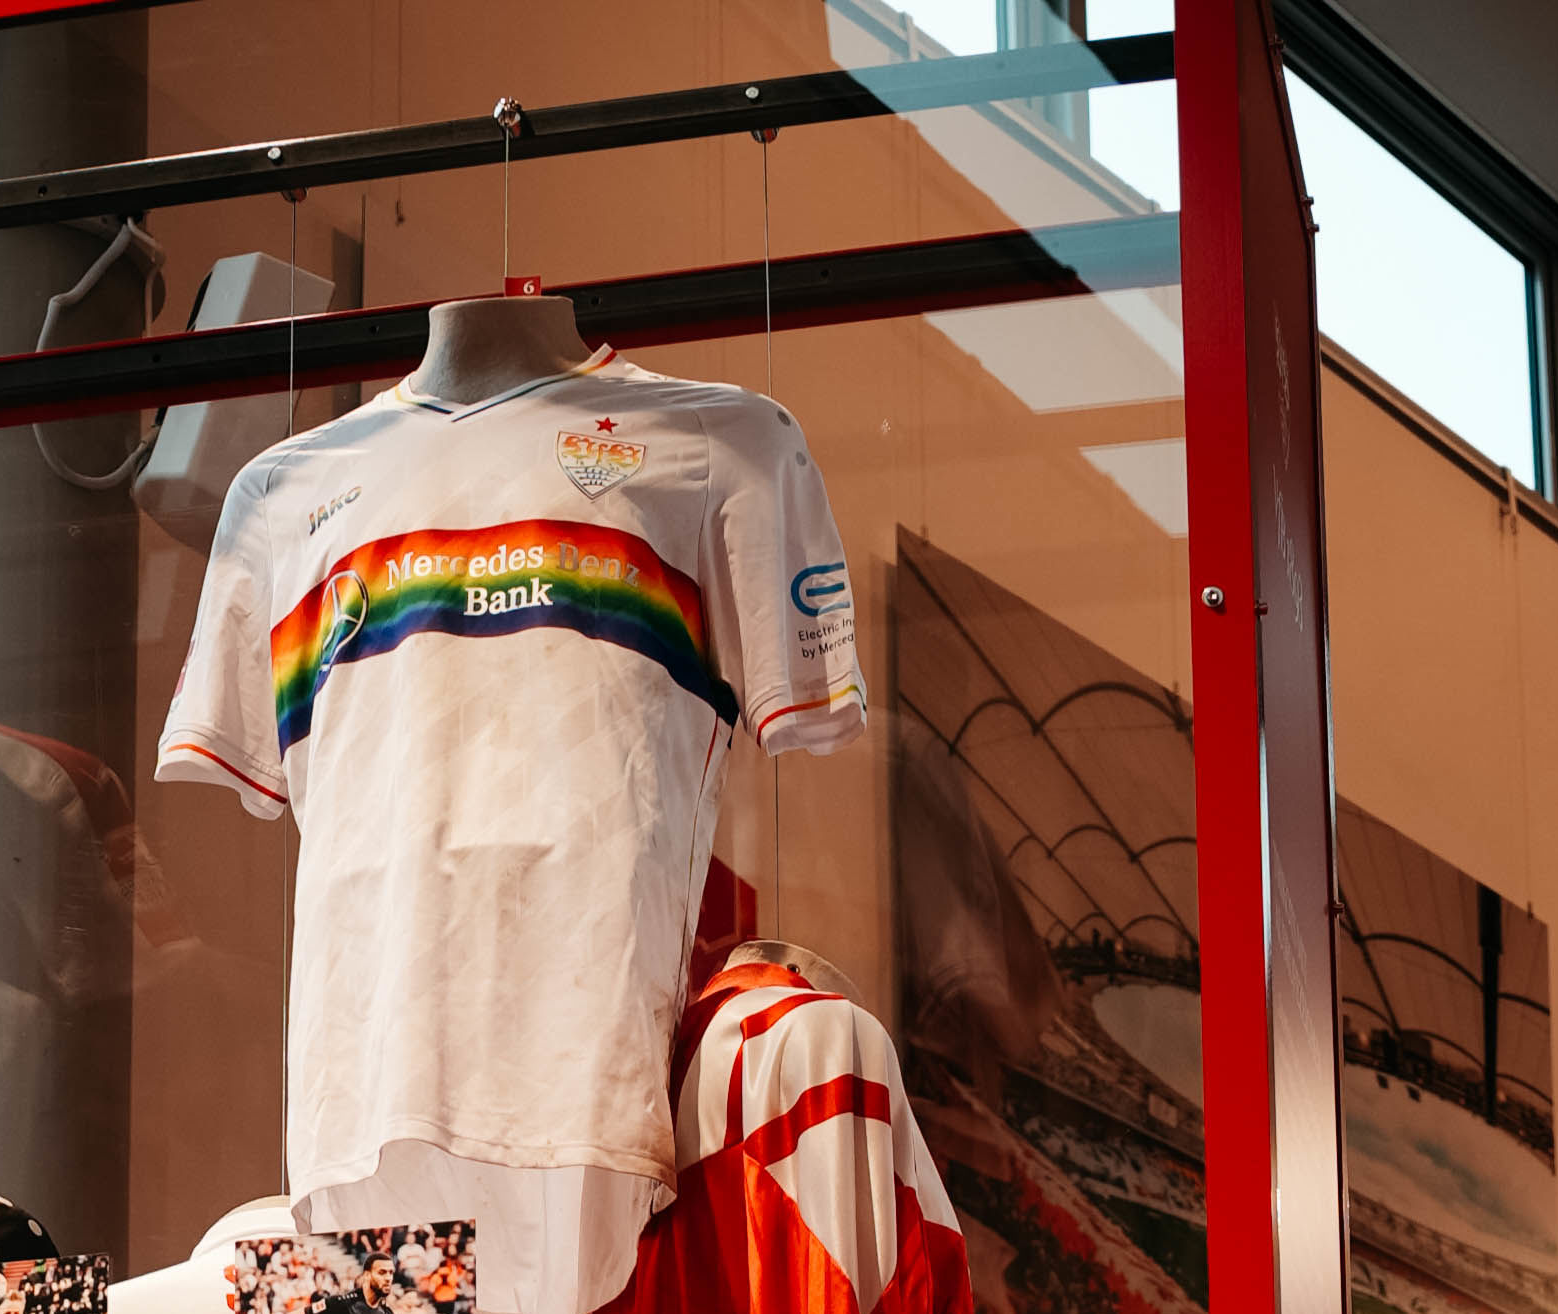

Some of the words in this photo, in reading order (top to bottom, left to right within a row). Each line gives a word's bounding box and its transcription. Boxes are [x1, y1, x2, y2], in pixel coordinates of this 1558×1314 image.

[522, 279, 535, 295] 6
[309, 486, 362, 536] JAKO
[385, 540, 641, 592] Mercedes-Benz
[463, 578, 553, 617] Bank
[798, 622, 840, 642] Electric
[801, 647, 816, 661] by
